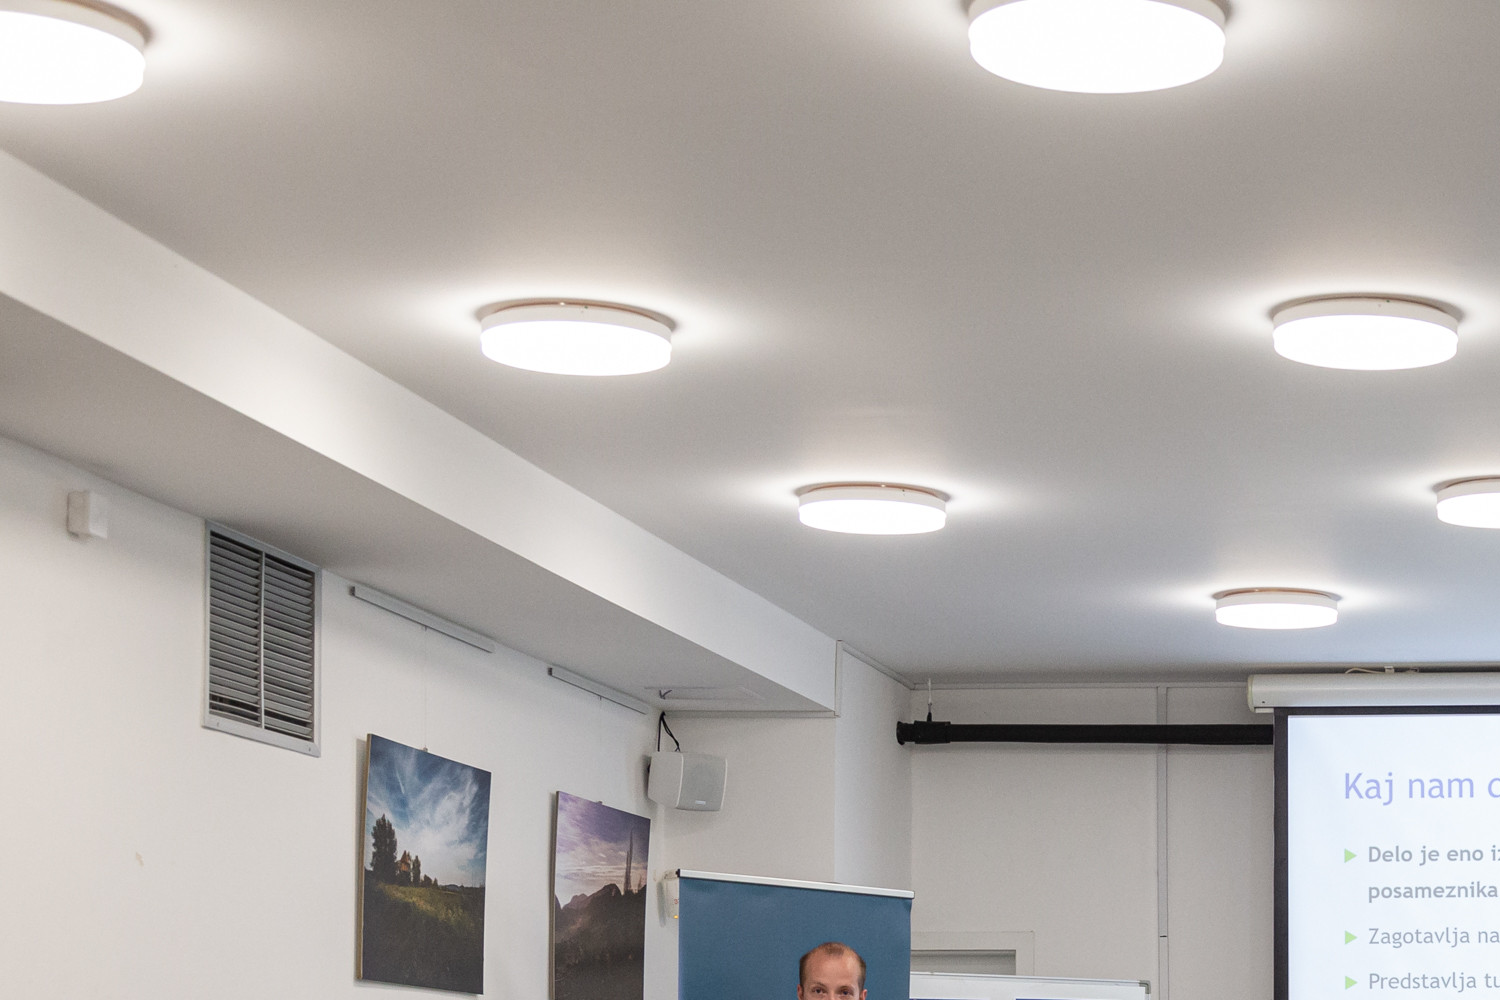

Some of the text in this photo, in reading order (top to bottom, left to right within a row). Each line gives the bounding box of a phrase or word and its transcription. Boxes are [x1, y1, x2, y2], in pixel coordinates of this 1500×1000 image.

[1344, 771, 1394, 807] Kaj
[1408, 777, 1475, 799] nam
[1368, 844, 1413, 863] Delo
[1418, 844, 1440, 867] je
[1446, 848, 1484, 862] eno
[1368, 880, 1498, 904] posameznika
[1368, 926, 1471, 949] Zagotavlja
[1369, 971, 1477, 994] Predstavlja
